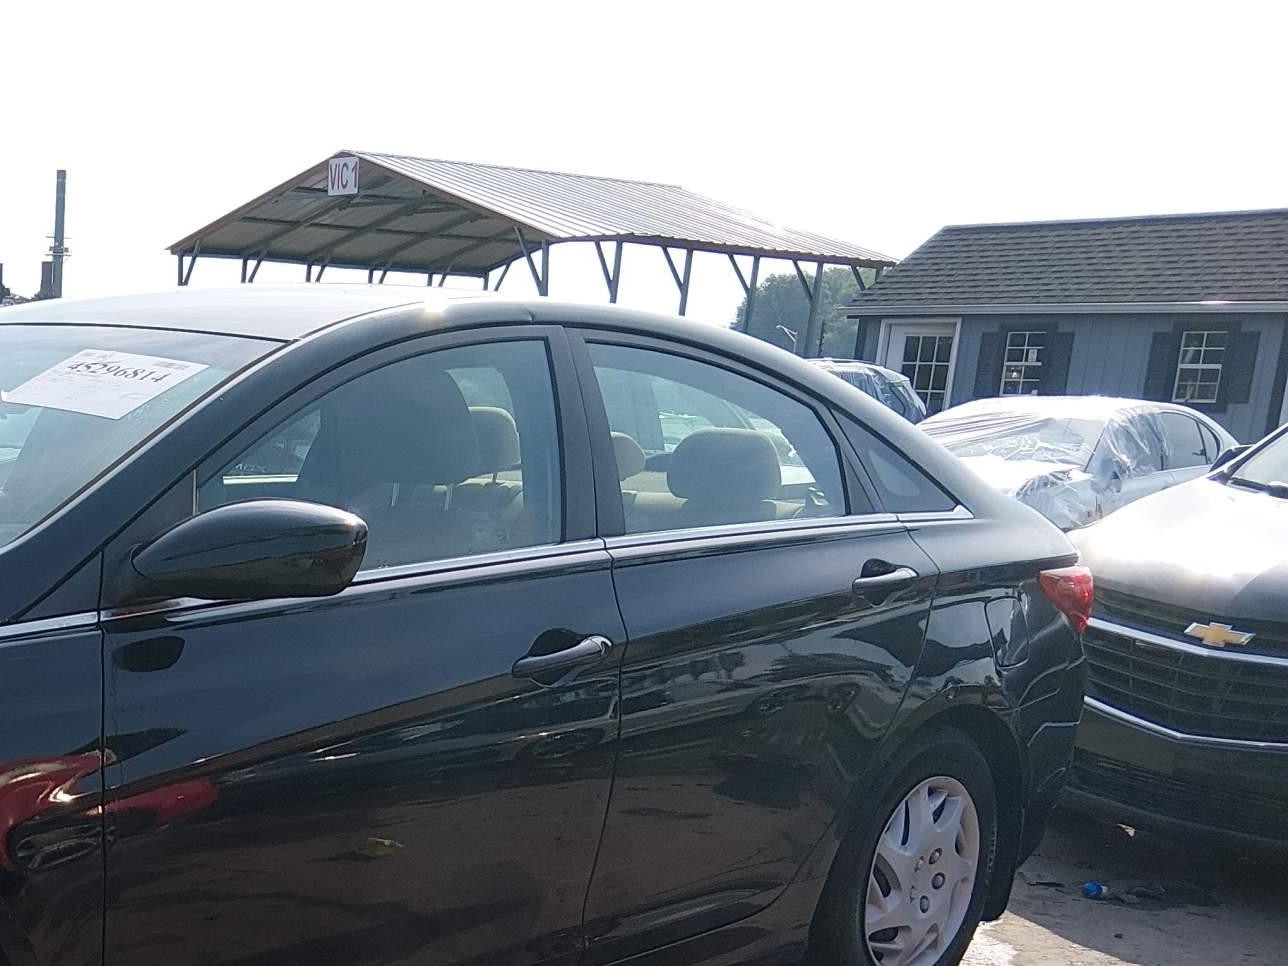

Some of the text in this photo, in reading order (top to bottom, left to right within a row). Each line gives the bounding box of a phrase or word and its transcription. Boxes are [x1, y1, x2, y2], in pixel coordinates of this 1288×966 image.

[330, 161, 358, 190] VIC 1
[67, 362, 172, 383] 45296814
